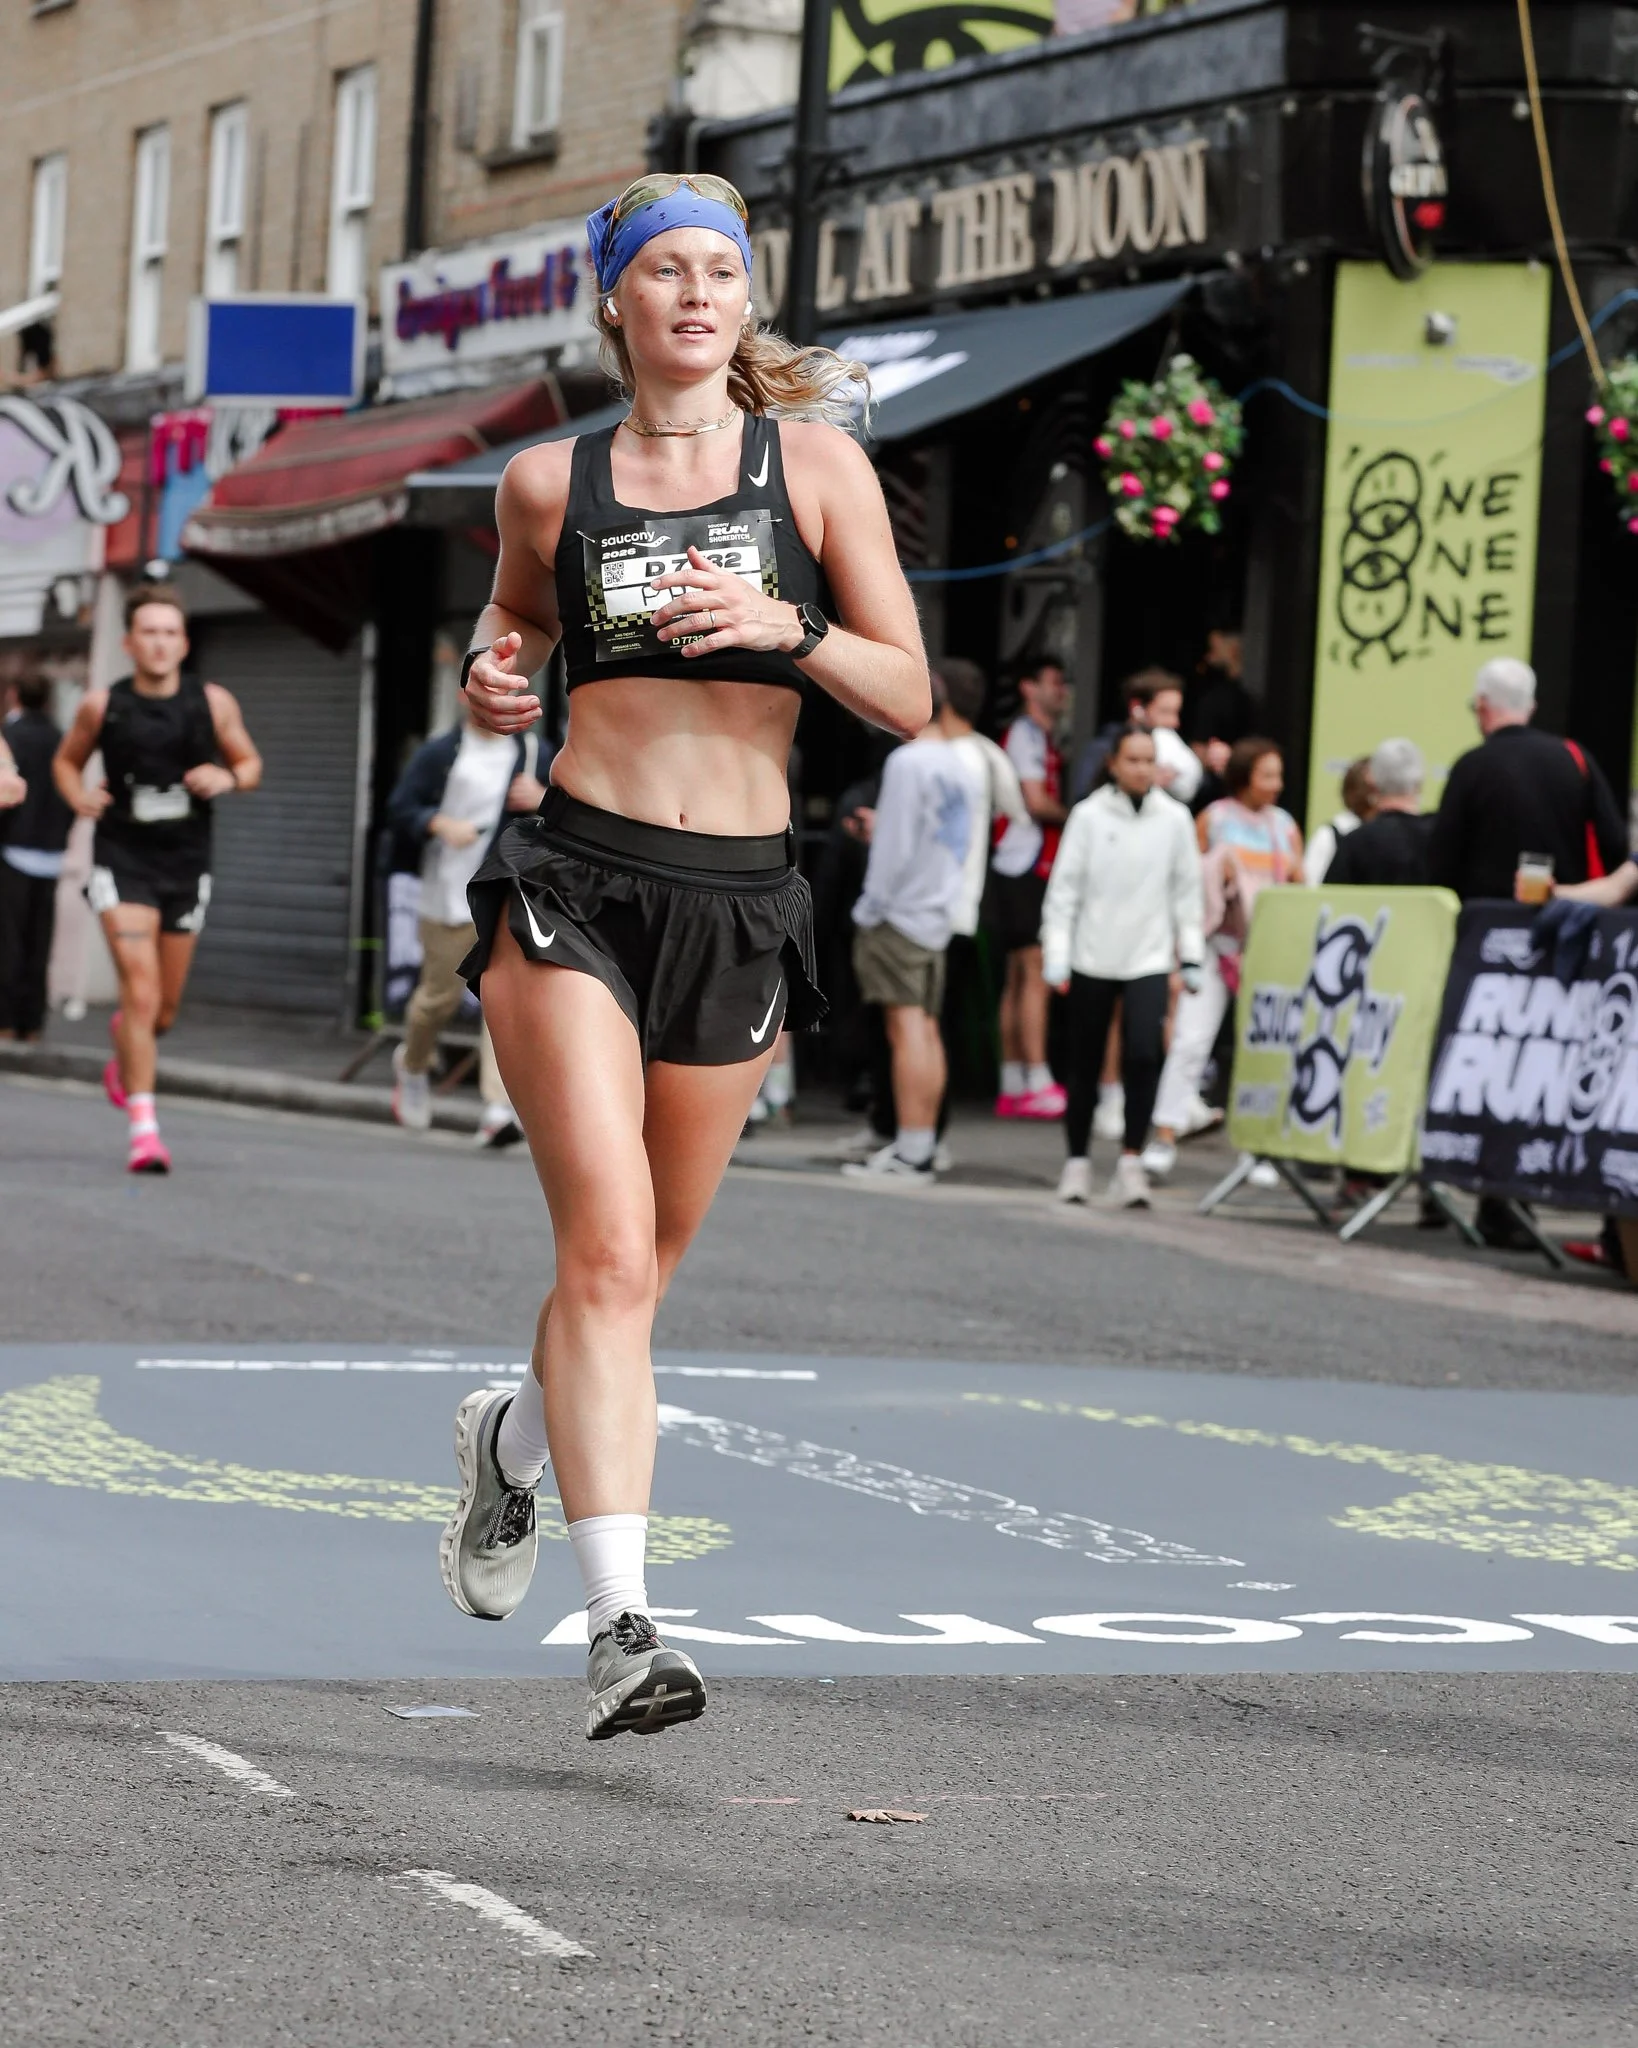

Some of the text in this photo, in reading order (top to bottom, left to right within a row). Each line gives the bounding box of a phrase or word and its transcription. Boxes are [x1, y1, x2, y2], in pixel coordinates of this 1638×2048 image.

[853, 196, 922, 302] AT
[931, 171, 1038, 289] THE
[708, 524, 749, 537] RUN
[601, 531, 655, 548] saucony
[708, 533, 751, 543] SHOREDITCH
[601, 547, 637, 561] 2026
[645, 551, 742, 577] D 732
[672, 636, 681, 646] D
